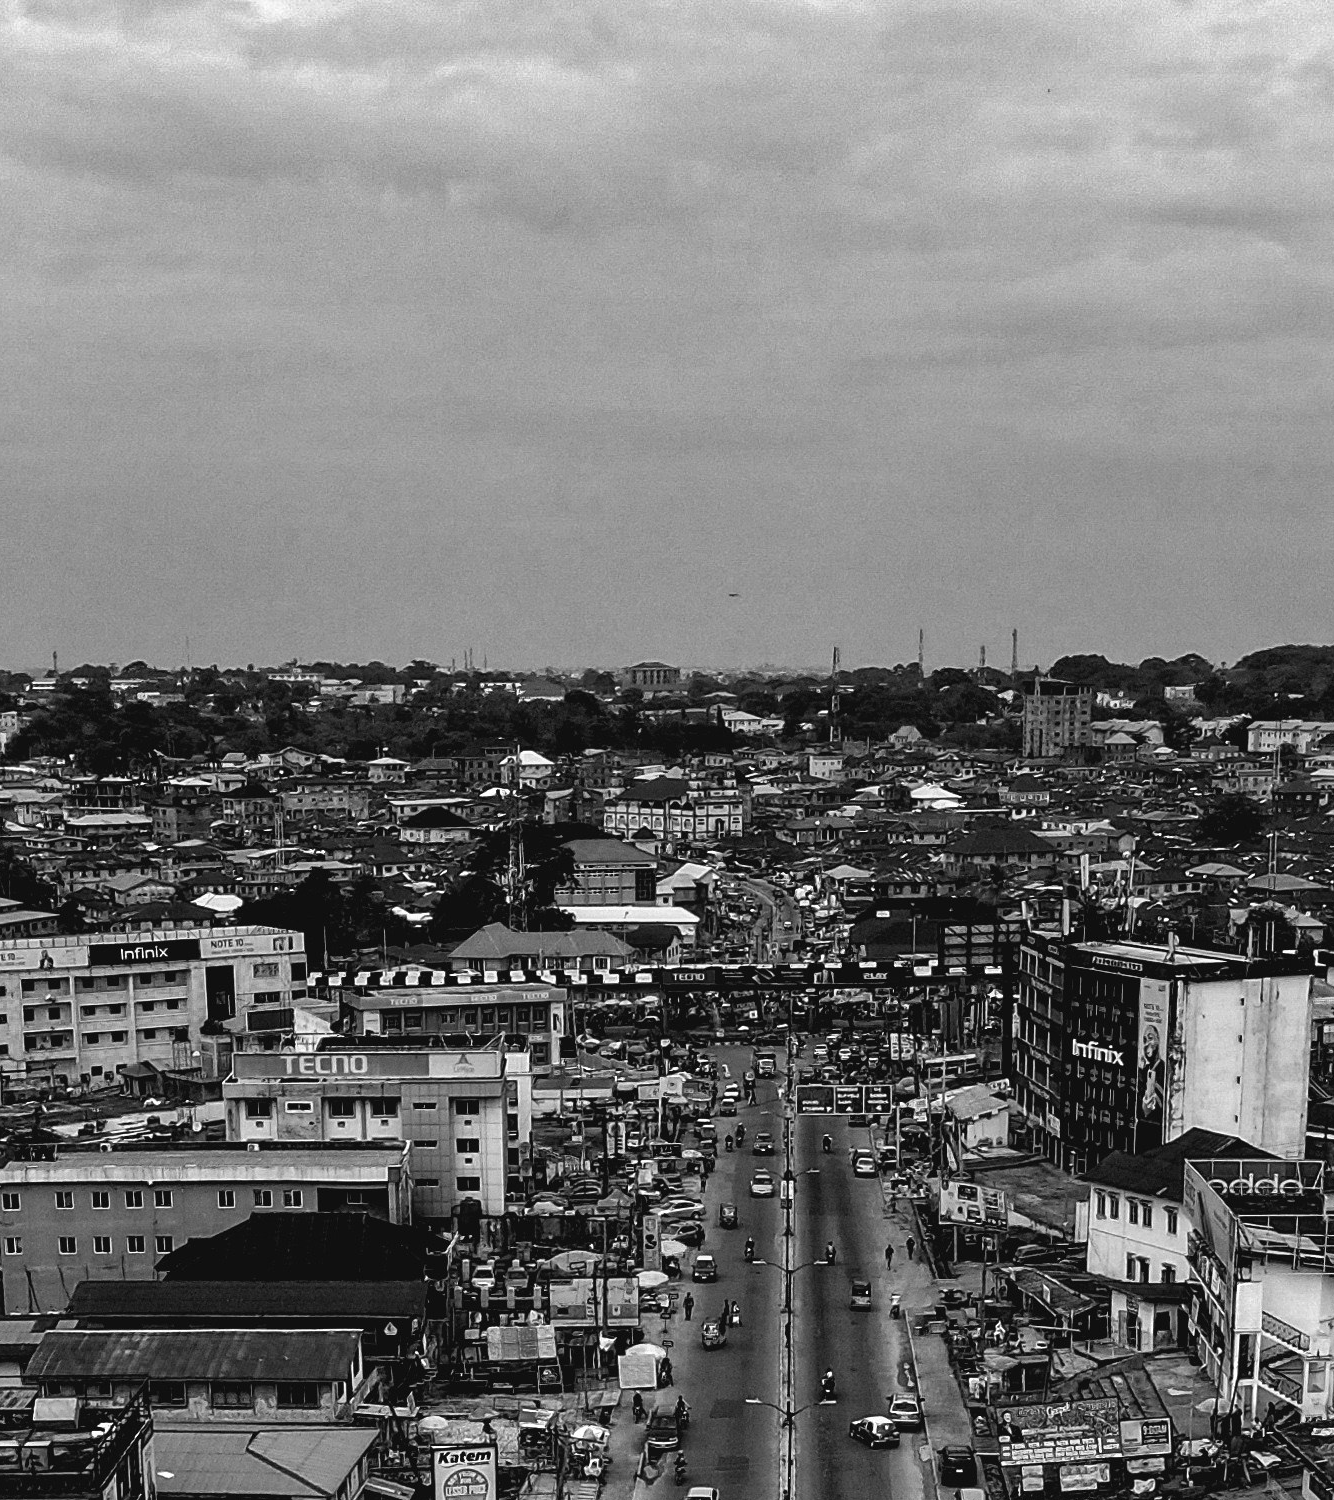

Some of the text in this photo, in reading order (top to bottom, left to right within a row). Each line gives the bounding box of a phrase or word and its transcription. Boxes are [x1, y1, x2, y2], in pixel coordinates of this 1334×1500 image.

[211, 938, 244, 948] NOTE 10
[7, 953, 15, 961] 10
[120, 945, 168, 960] Infinix
[672, 972, 705, 981] TECNO
[1072, 1038, 1124, 1067] Infinix
[280, 1055, 368, 1075] TECNO
[438, 1451, 491, 1465] Katem
